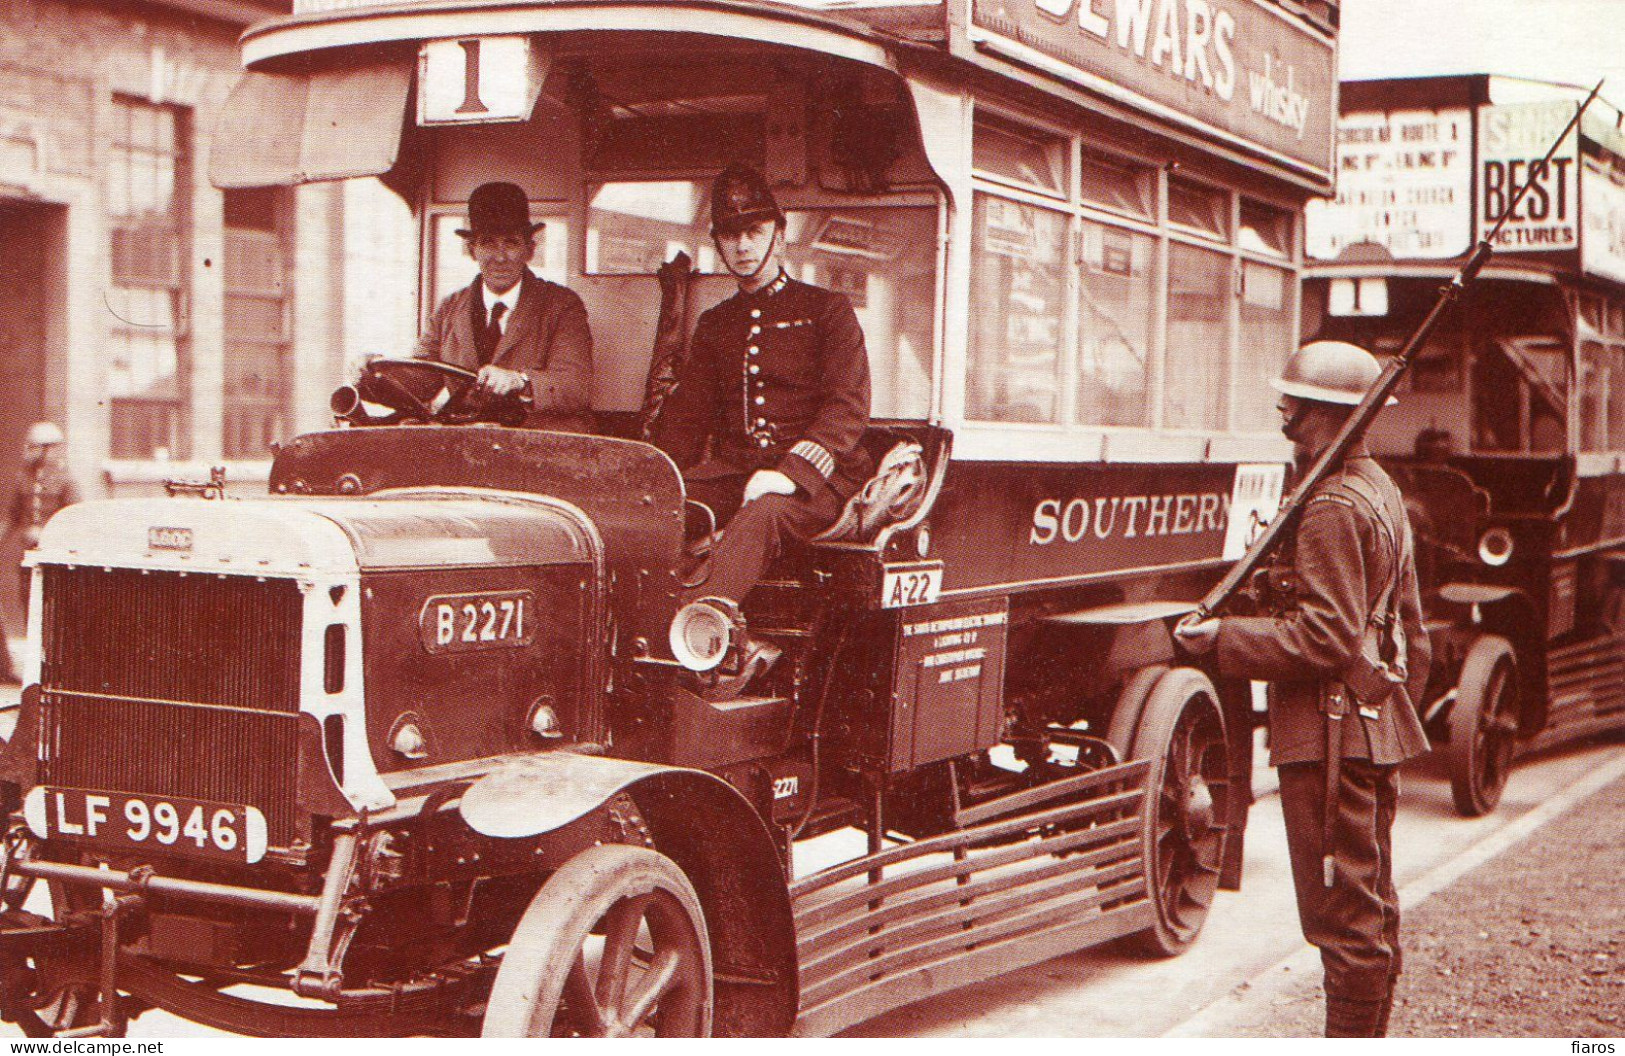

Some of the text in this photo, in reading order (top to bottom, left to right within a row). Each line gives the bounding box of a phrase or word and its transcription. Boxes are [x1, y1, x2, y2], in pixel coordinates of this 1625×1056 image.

[455, 40, 489, 114] 1
[1249, 52, 1308, 139] whisky
[1484, 158, 1574, 222] BEST
[437, 599, 523, 646] B 2271
[56, 792, 237, 851] LF 9946
